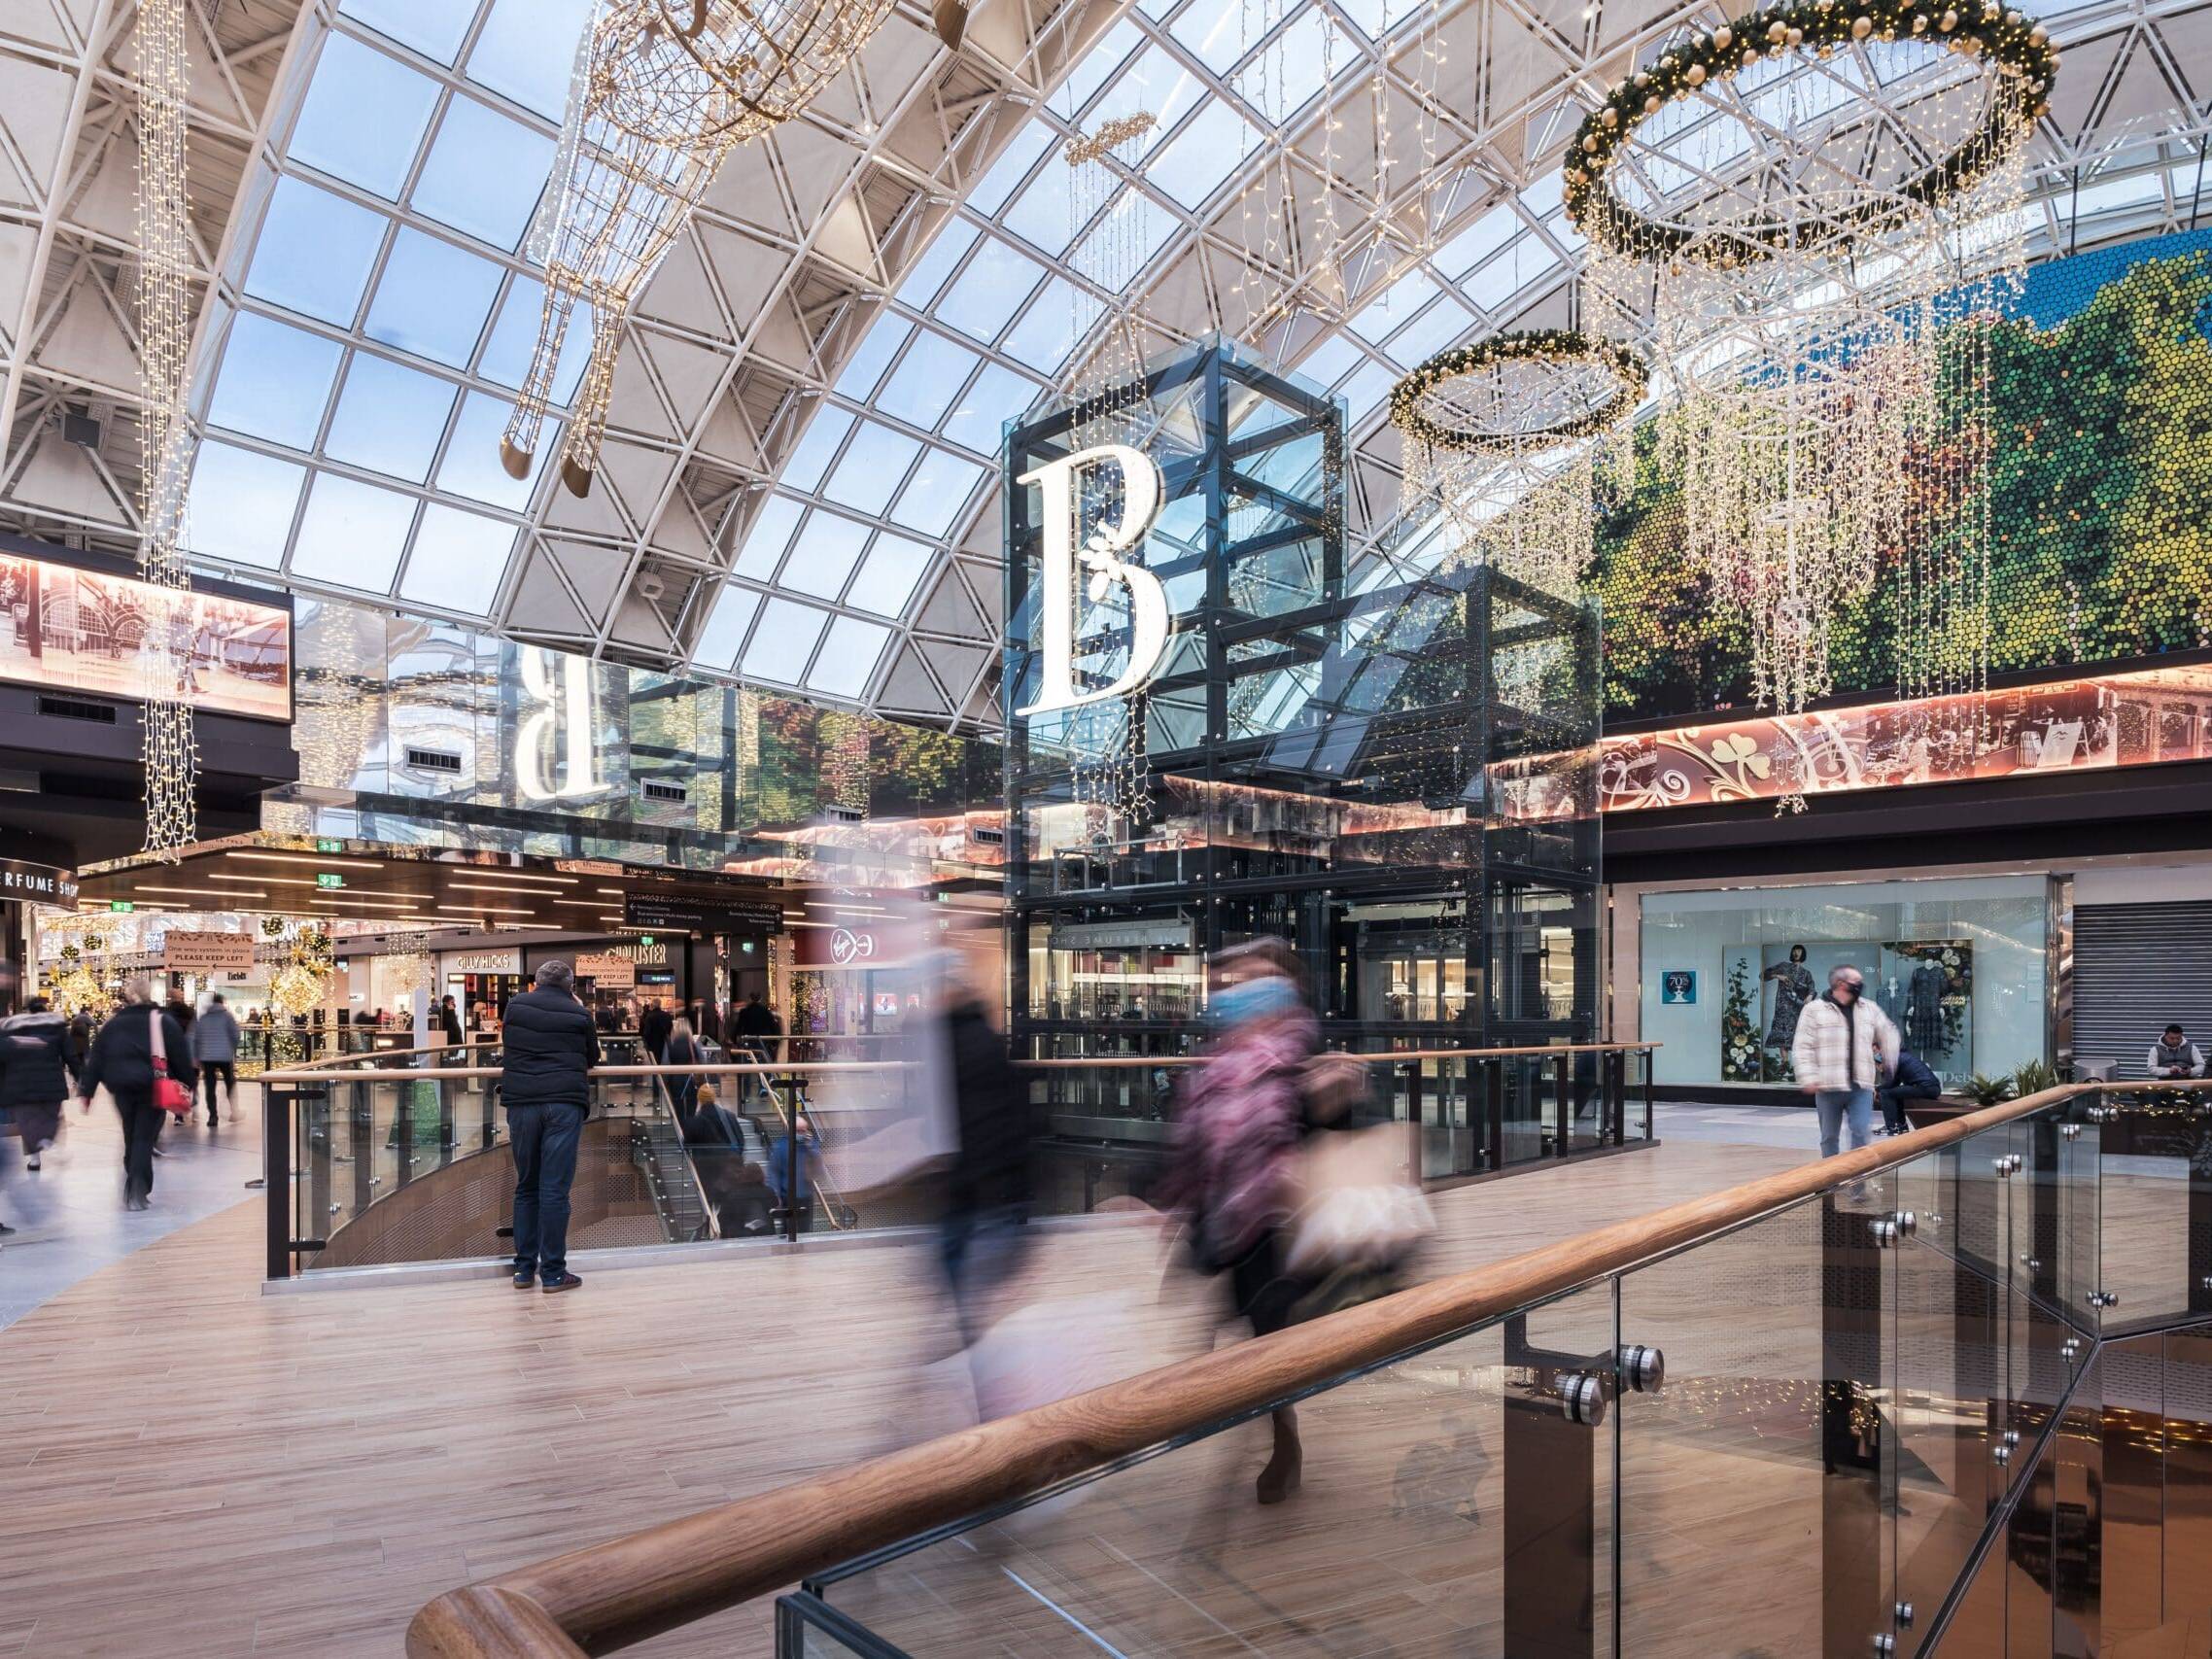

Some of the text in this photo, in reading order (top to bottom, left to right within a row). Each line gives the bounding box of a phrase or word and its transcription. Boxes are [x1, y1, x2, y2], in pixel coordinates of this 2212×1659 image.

[1016, 445, 1168, 716] B
[0, 871, 53, 892] RFUME
[458, 954, 510, 969] GILLY HICKS
